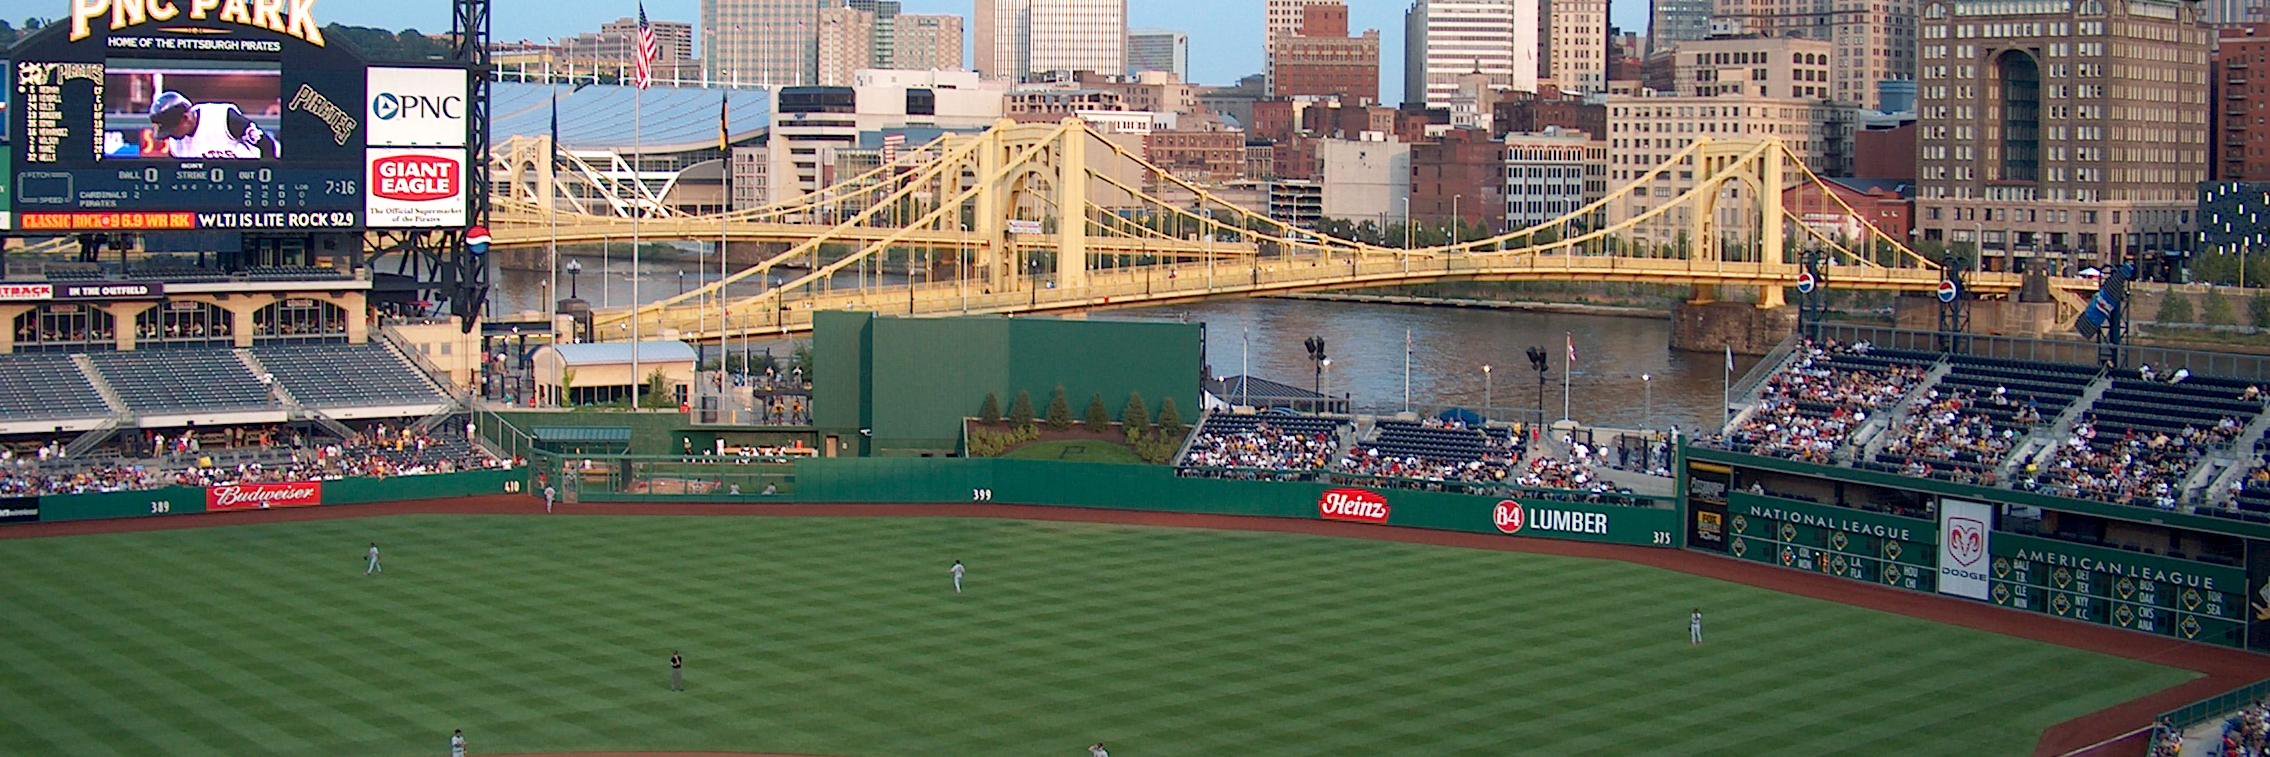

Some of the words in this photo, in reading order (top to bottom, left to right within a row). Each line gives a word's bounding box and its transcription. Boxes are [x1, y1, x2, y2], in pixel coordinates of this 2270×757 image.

[107, 37, 136, 48] HOME
[138, 38, 152, 48] OF
[154, 38, 175, 49] THE
[176, 39, 239, 51] PITTSBURGH
[240, 41, 281, 53] PIRATES
[399, 95, 461, 119] PNC
[289, 84, 357, 145] PIRATES
[119, 171, 141, 179] BALL
[145, 168, 158, 182] 0
[176, 171, 208, 179] STRIKE
[211, 168, 224, 182] 0
[239, 171, 254, 180] OUT
[259, 168, 272, 182] 0
[379, 162, 452, 178] GIANT
[326, 181, 356, 195] 7:16
[382, 178, 450, 194] EAGLE
[80, 191, 128, 199] CARDINALS
[134, 191, 140, 199] 2
[278, 191, 285, 199] 0
[23, 214, 71, 229] CLASSIC
[73, 214, 102, 229] ROCK
[199, 213, 236, 227] WLTJ
[240, 213, 253, 227] IS
[255, 213, 284, 227] LITE
[289, 213, 329, 227] ROCK
[330, 212, 354, 227] 92.9
[69, 287, 81, 296] IN
[82, 287, 101, 296] THE
[102, 286, 148, 296] OUTFIELD
[504, 480, 520, 493] 410
[213, 485, 315, 505] Budweiser
[973, 489, 992, 501] 399
[151, 501, 170, 513] 389
[1322, 493, 1386, 518] Heinz
[1496, 505, 1521, 528] 84
[1530, 508, 1608, 534] LUMBER
[1751, 505, 1836, 530] NATIONAL
[1842, 520, 1910, 541] LEAGUE
[1653, 531, 1671, 545] 375
[1904, 566, 1919, 577] HOU
[1942, 567, 1987, 582] DODGE
[2016, 548, 2124, 575] AMERICAN
[2130, 564, 2213, 590] LEAGUE
[1905, 577, 1917, 589] CHI
[2076, 581, 2089, 594] TEX
[2139, 579, 2154, 592] BOS
[2014, 585, 2027, 597] CLE
[2206, 603, 2221, 615] SEA
